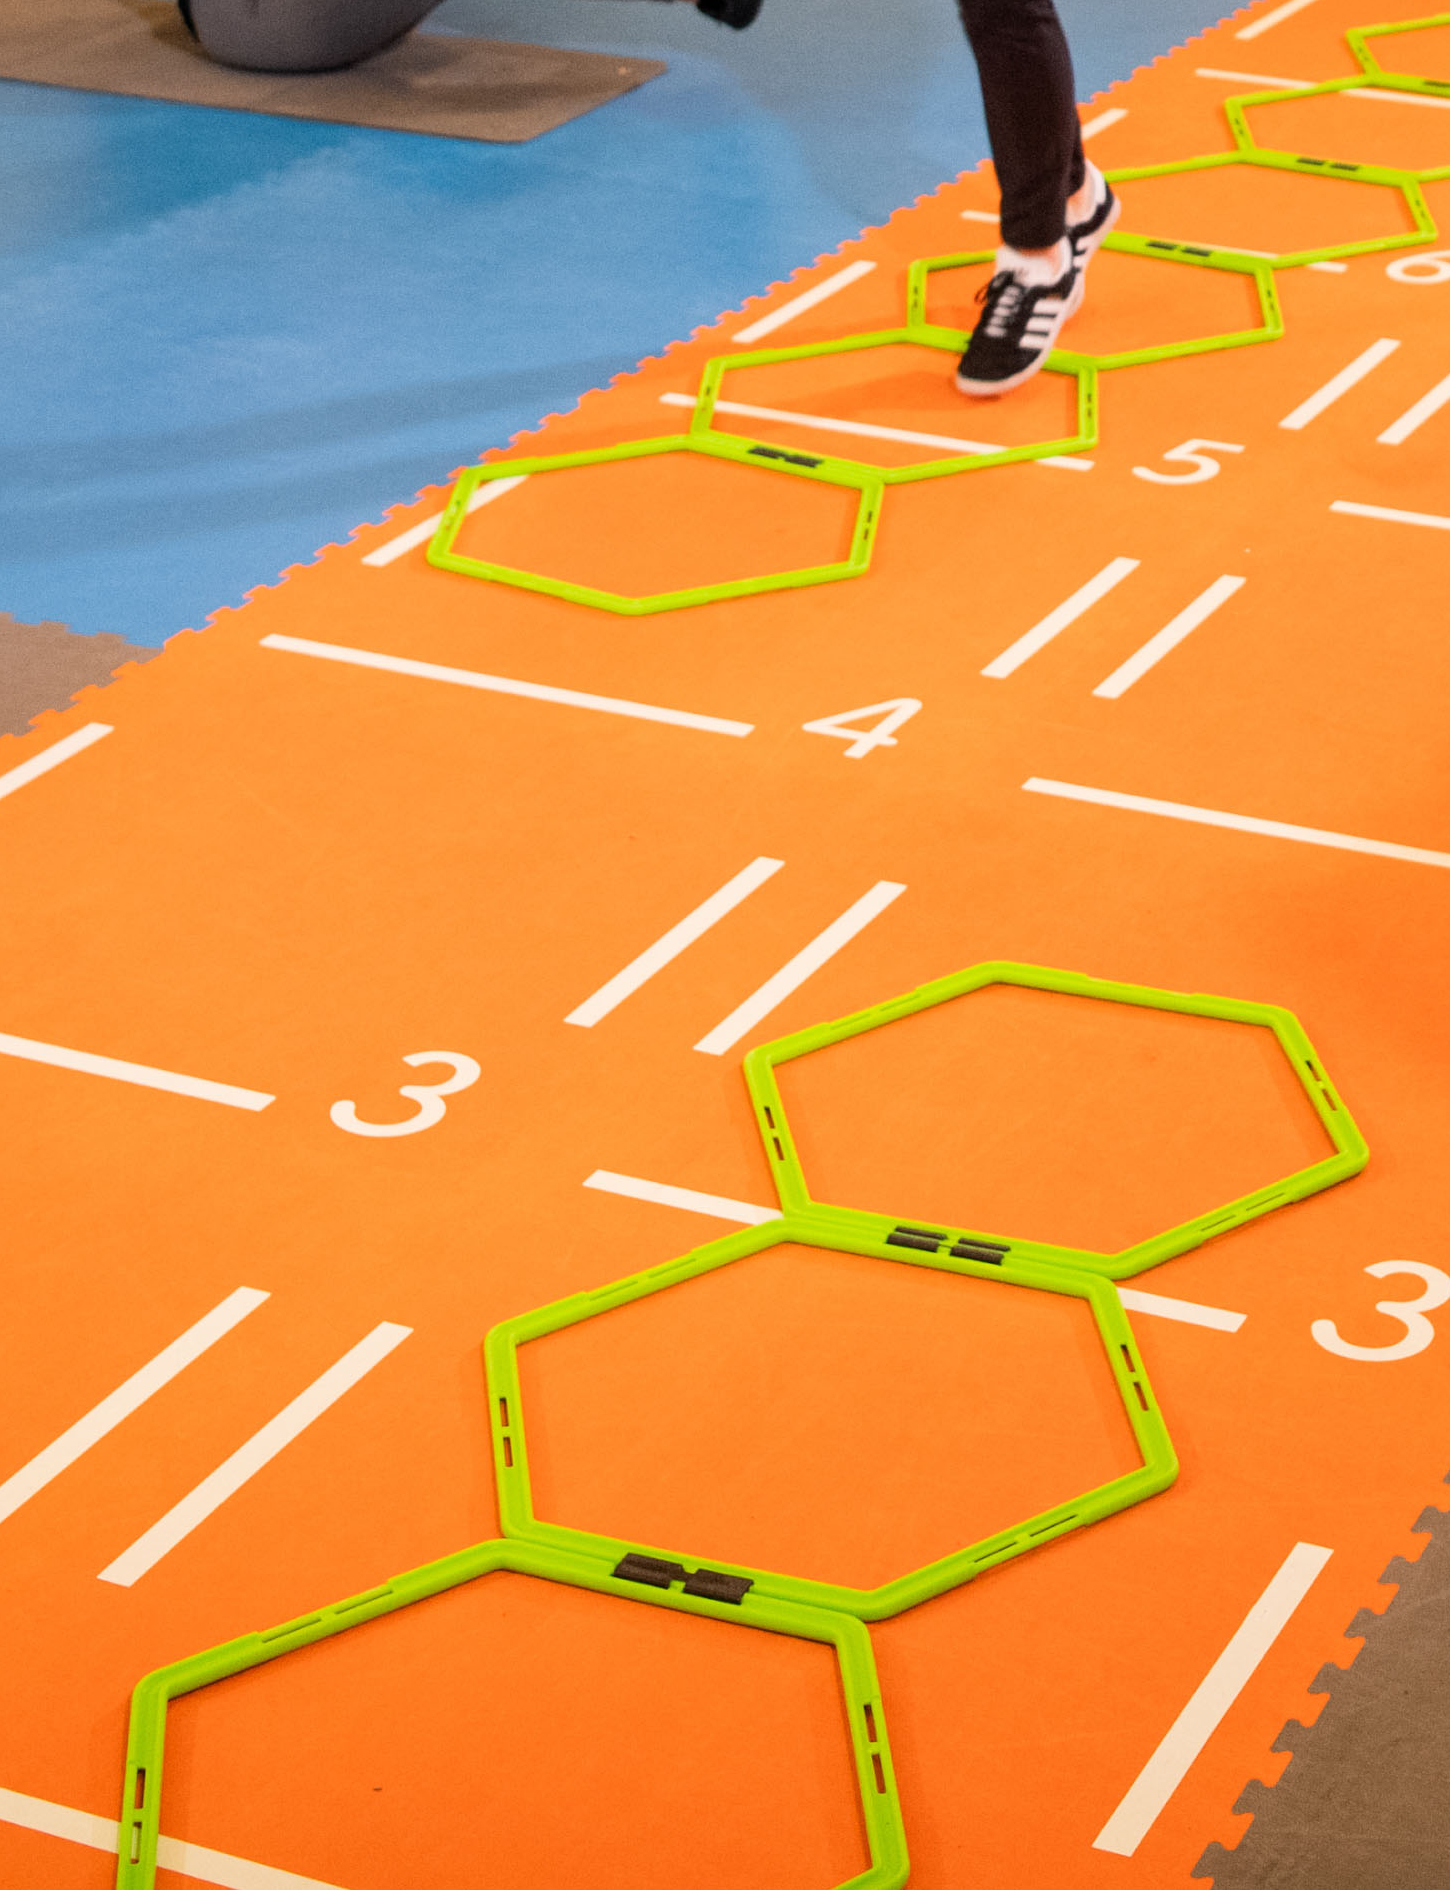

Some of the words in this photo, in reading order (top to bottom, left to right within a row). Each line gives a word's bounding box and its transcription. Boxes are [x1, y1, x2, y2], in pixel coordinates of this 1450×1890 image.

[1131, 437, 1245, 486] 5
[801, 697, 923, 760] 4
[329, 1049, 482, 1139] 3
